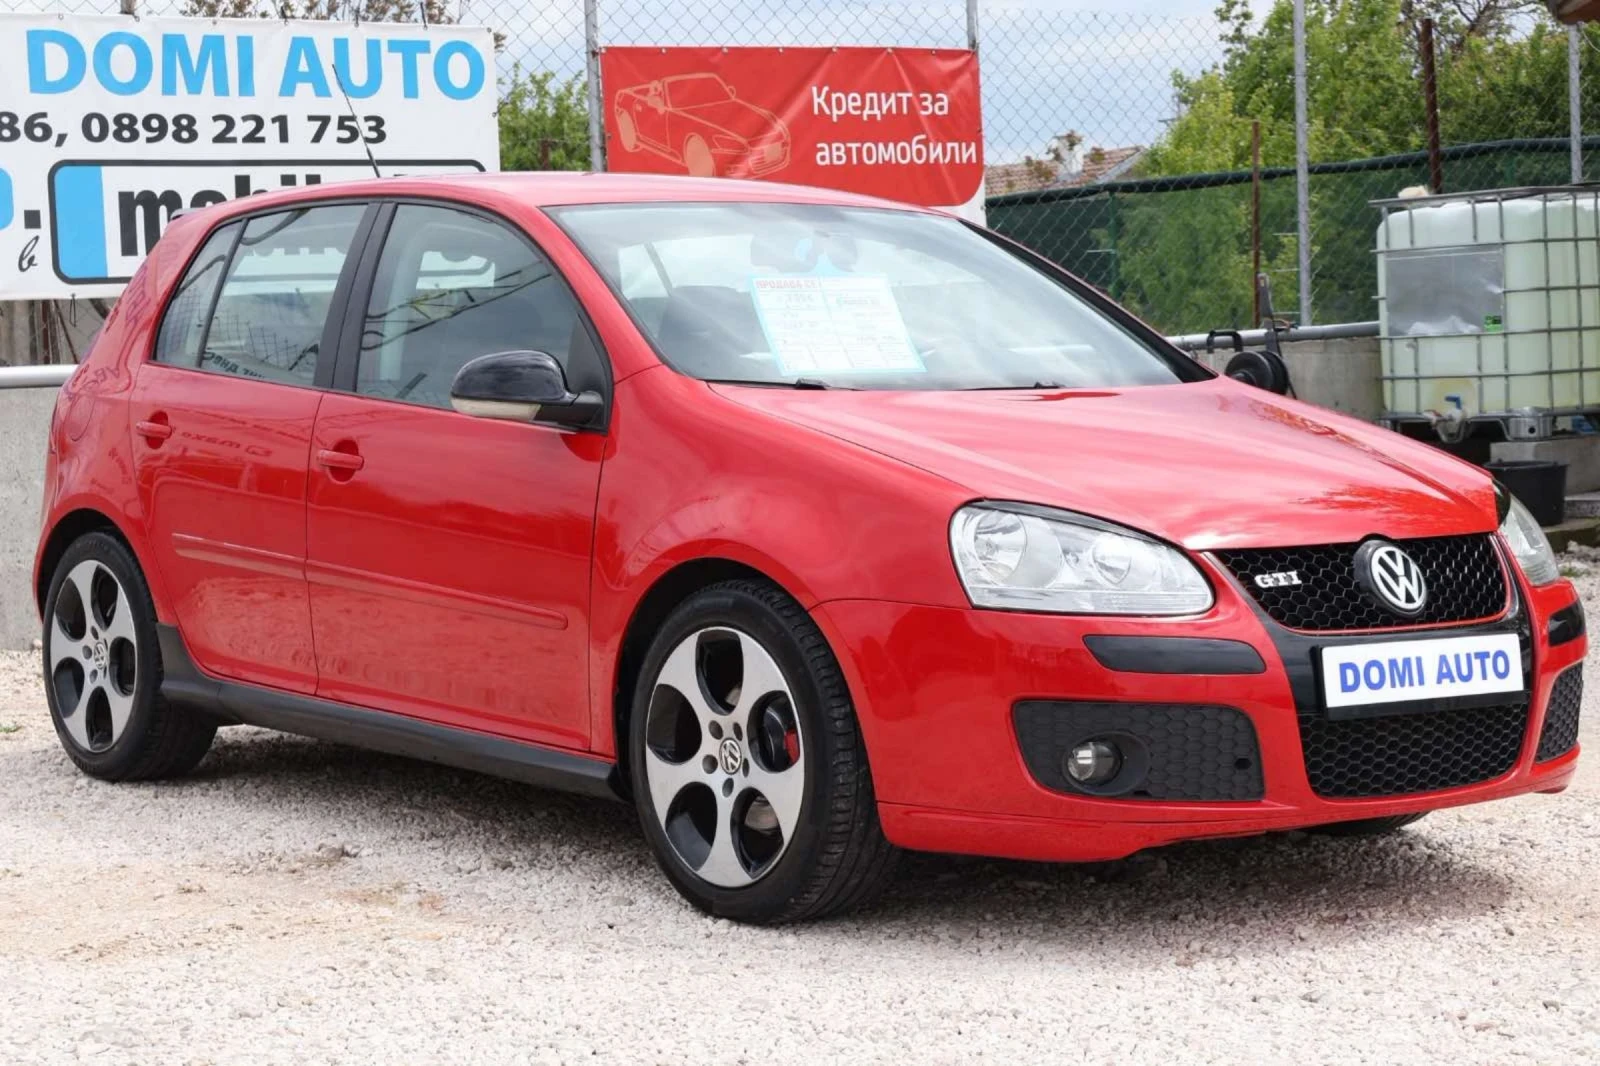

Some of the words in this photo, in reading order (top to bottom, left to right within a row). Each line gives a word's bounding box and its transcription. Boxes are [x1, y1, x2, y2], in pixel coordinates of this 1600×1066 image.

[26, 29, 255, 97] DOMI
[279, 36, 485, 100] AUTO
[811, 86, 913, 122] Кредит
[919, 92, 949, 116] за
[81, 112, 199, 144] 0898
[211, 114, 290, 144] 221
[307, 114, 387, 145] 753
[816, 135, 977, 165] автомобили
[1254, 570, 1302, 588] GTI
[1339, 656, 1425, 693] DOMI
[1436, 649, 1510, 684] AUTO
